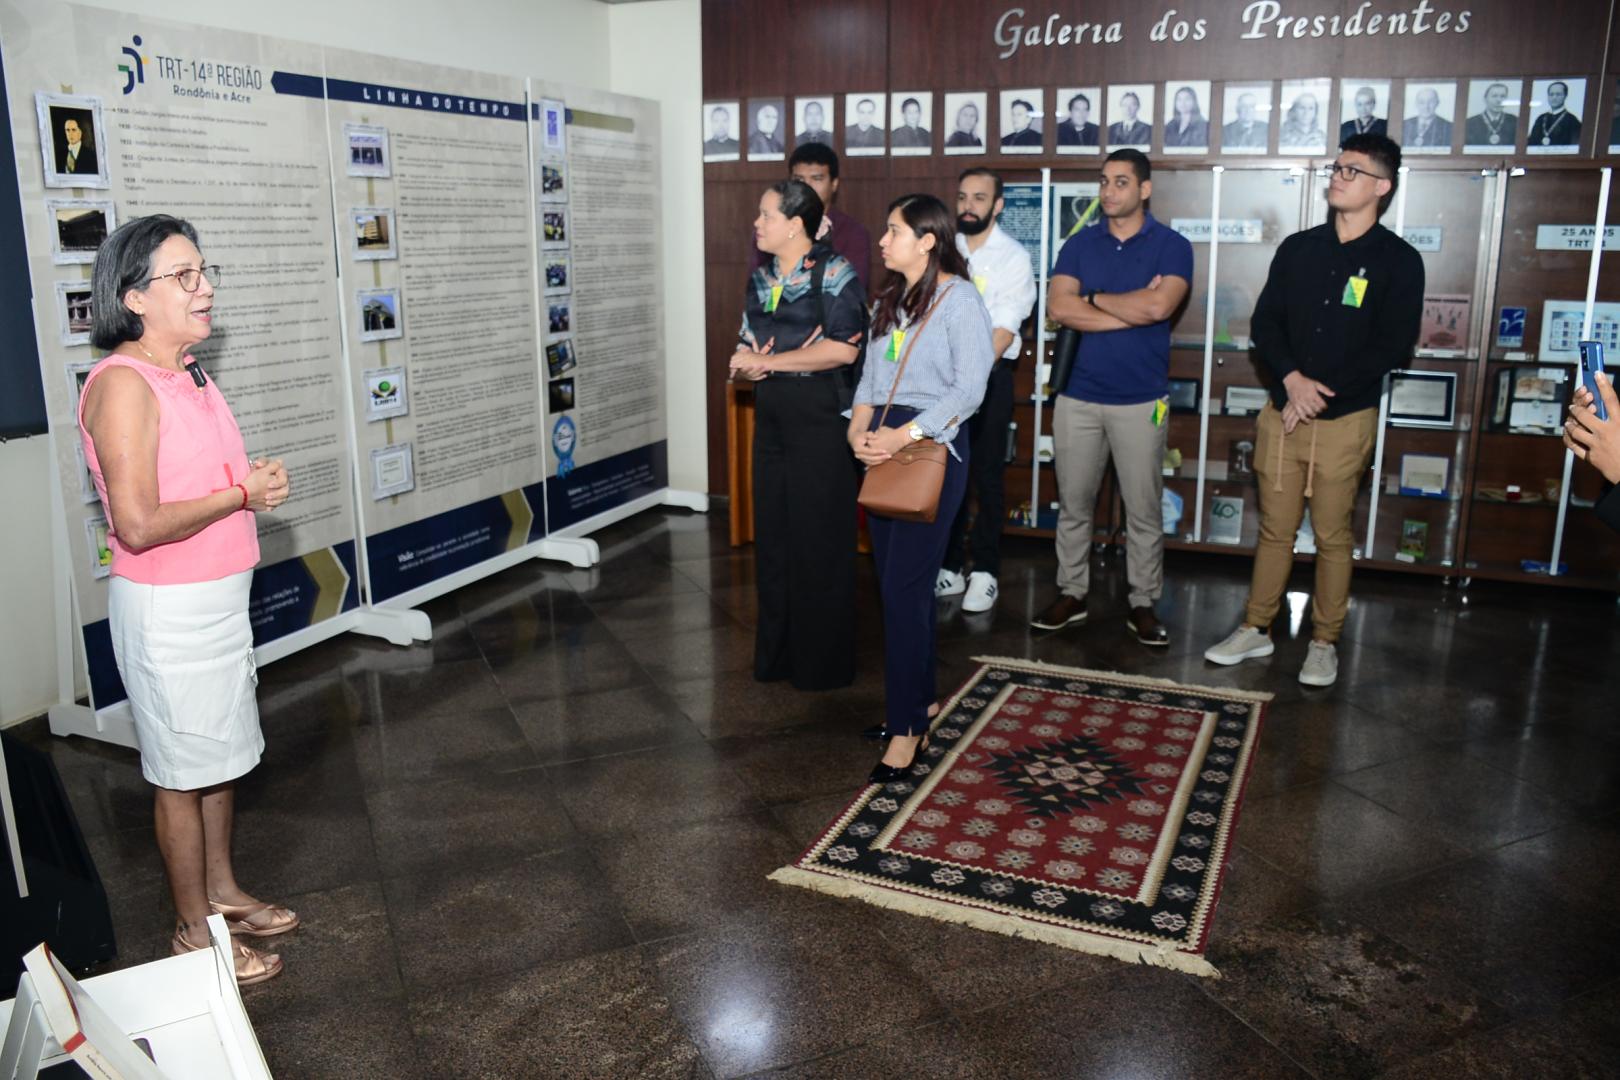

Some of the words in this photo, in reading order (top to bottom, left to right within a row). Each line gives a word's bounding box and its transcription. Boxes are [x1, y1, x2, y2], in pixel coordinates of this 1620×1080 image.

[994, 8, 1124, 60] Galeria
[1149, 9, 1207, 43] dos
[1240, 0, 1472, 41] Presidentes
[217, 64, 263, 91] REGIÃO
[173, 84, 220, 101] Rondônia
[223, 93, 228, 101] e
[231, 94, 252, 104] Acre
[362, 87, 423, 107] LINHA
[432, 96, 452, 110] DO
[458, 99, 510, 117] TEMPO
[1561, 228, 1576, 237] 25
[1568, 239, 1589, 248] TRT
